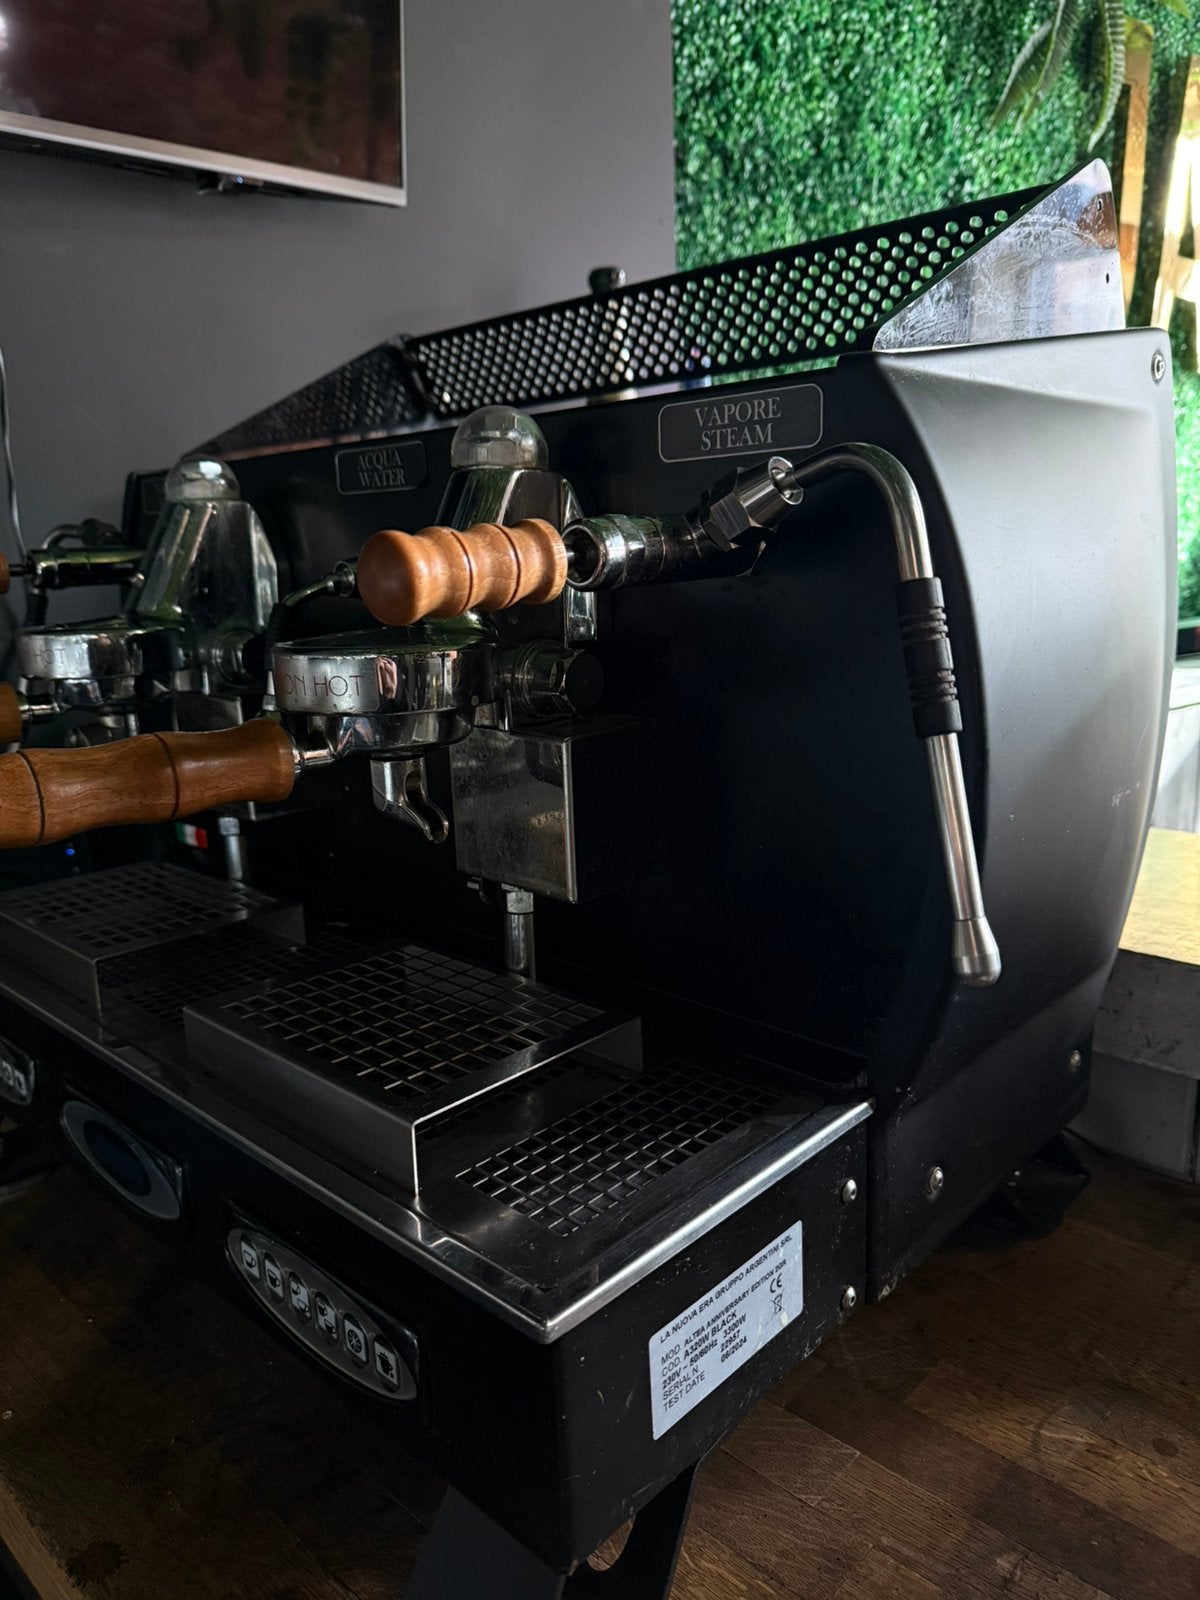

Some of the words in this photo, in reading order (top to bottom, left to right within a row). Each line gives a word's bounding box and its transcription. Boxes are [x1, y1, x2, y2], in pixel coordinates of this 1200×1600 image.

[694, 396, 782, 428] VAPORE
[700, 424, 774, 452] STEAM
[357, 448, 402, 470] ACQUA
[358, 468, 406, 488] WATER
[313, 674, 364, 697] HOT
[660, 1330, 671, 1344] LA
[671, 1310, 698, 1335] NUOVA
[698, 1297, 714, 1314] ERA
[714, 1272, 744, 1300] GRUPPO
[744, 1243, 779, 1277] ARGENTINI
[780, 1234, 792, 1248] SRL
[684, 1326, 705, 1348] ALTEA
[706, 1287, 750, 1330] ANNIVERSARY
[751, 1268, 774, 1293] EDITION
[683, 1332, 710, 1360] A320W
[711, 1310, 737, 1337] BLACK
[662, 1370, 682, 1390] 230V
[689, 1338, 718, 1367] 50/60Hz
[723, 1313, 747, 1339] 3300W
[663, 1376, 690, 1401] SERIAL
[663, 1391, 683, 1411] TEST
[685, 1370, 706, 1394] DATE
